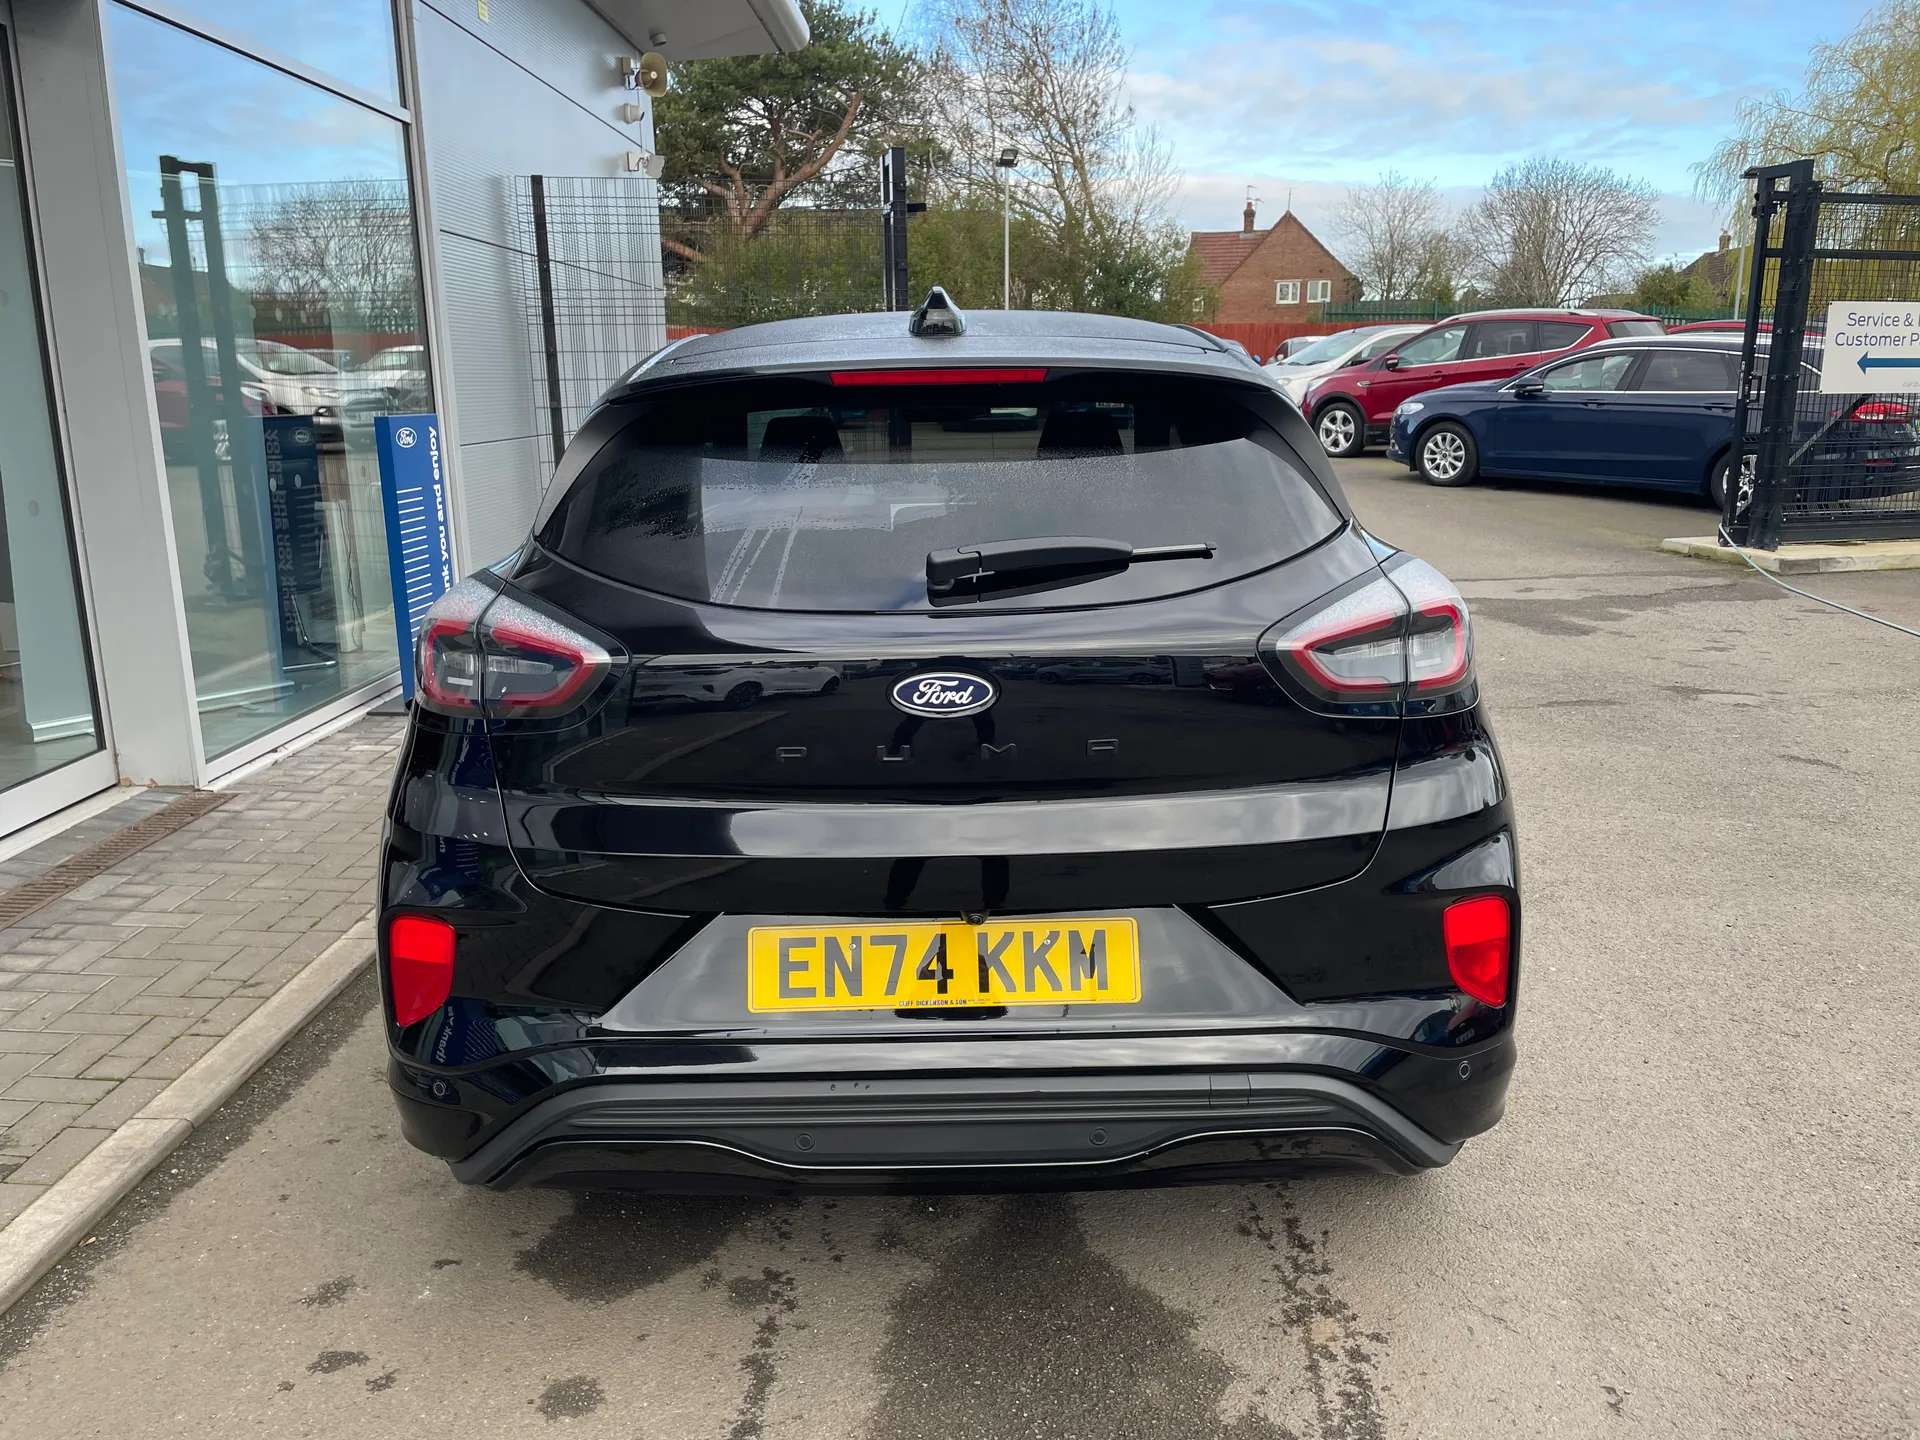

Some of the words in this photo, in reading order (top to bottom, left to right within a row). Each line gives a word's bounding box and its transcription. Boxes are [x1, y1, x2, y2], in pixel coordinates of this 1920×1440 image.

[1847, 312, 1900, 327] Service
[1903, 312, 1914, 327] &
[1835, 332, 1907, 347] Customer
[429, 426, 440, 480] enjoy
[433, 484, 444, 522] and
[439, 526, 449, 561] you
[912, 679, 973, 705] Ford
[779, 933, 954, 999] EN74
[977, 929, 1109, 993] KKM
